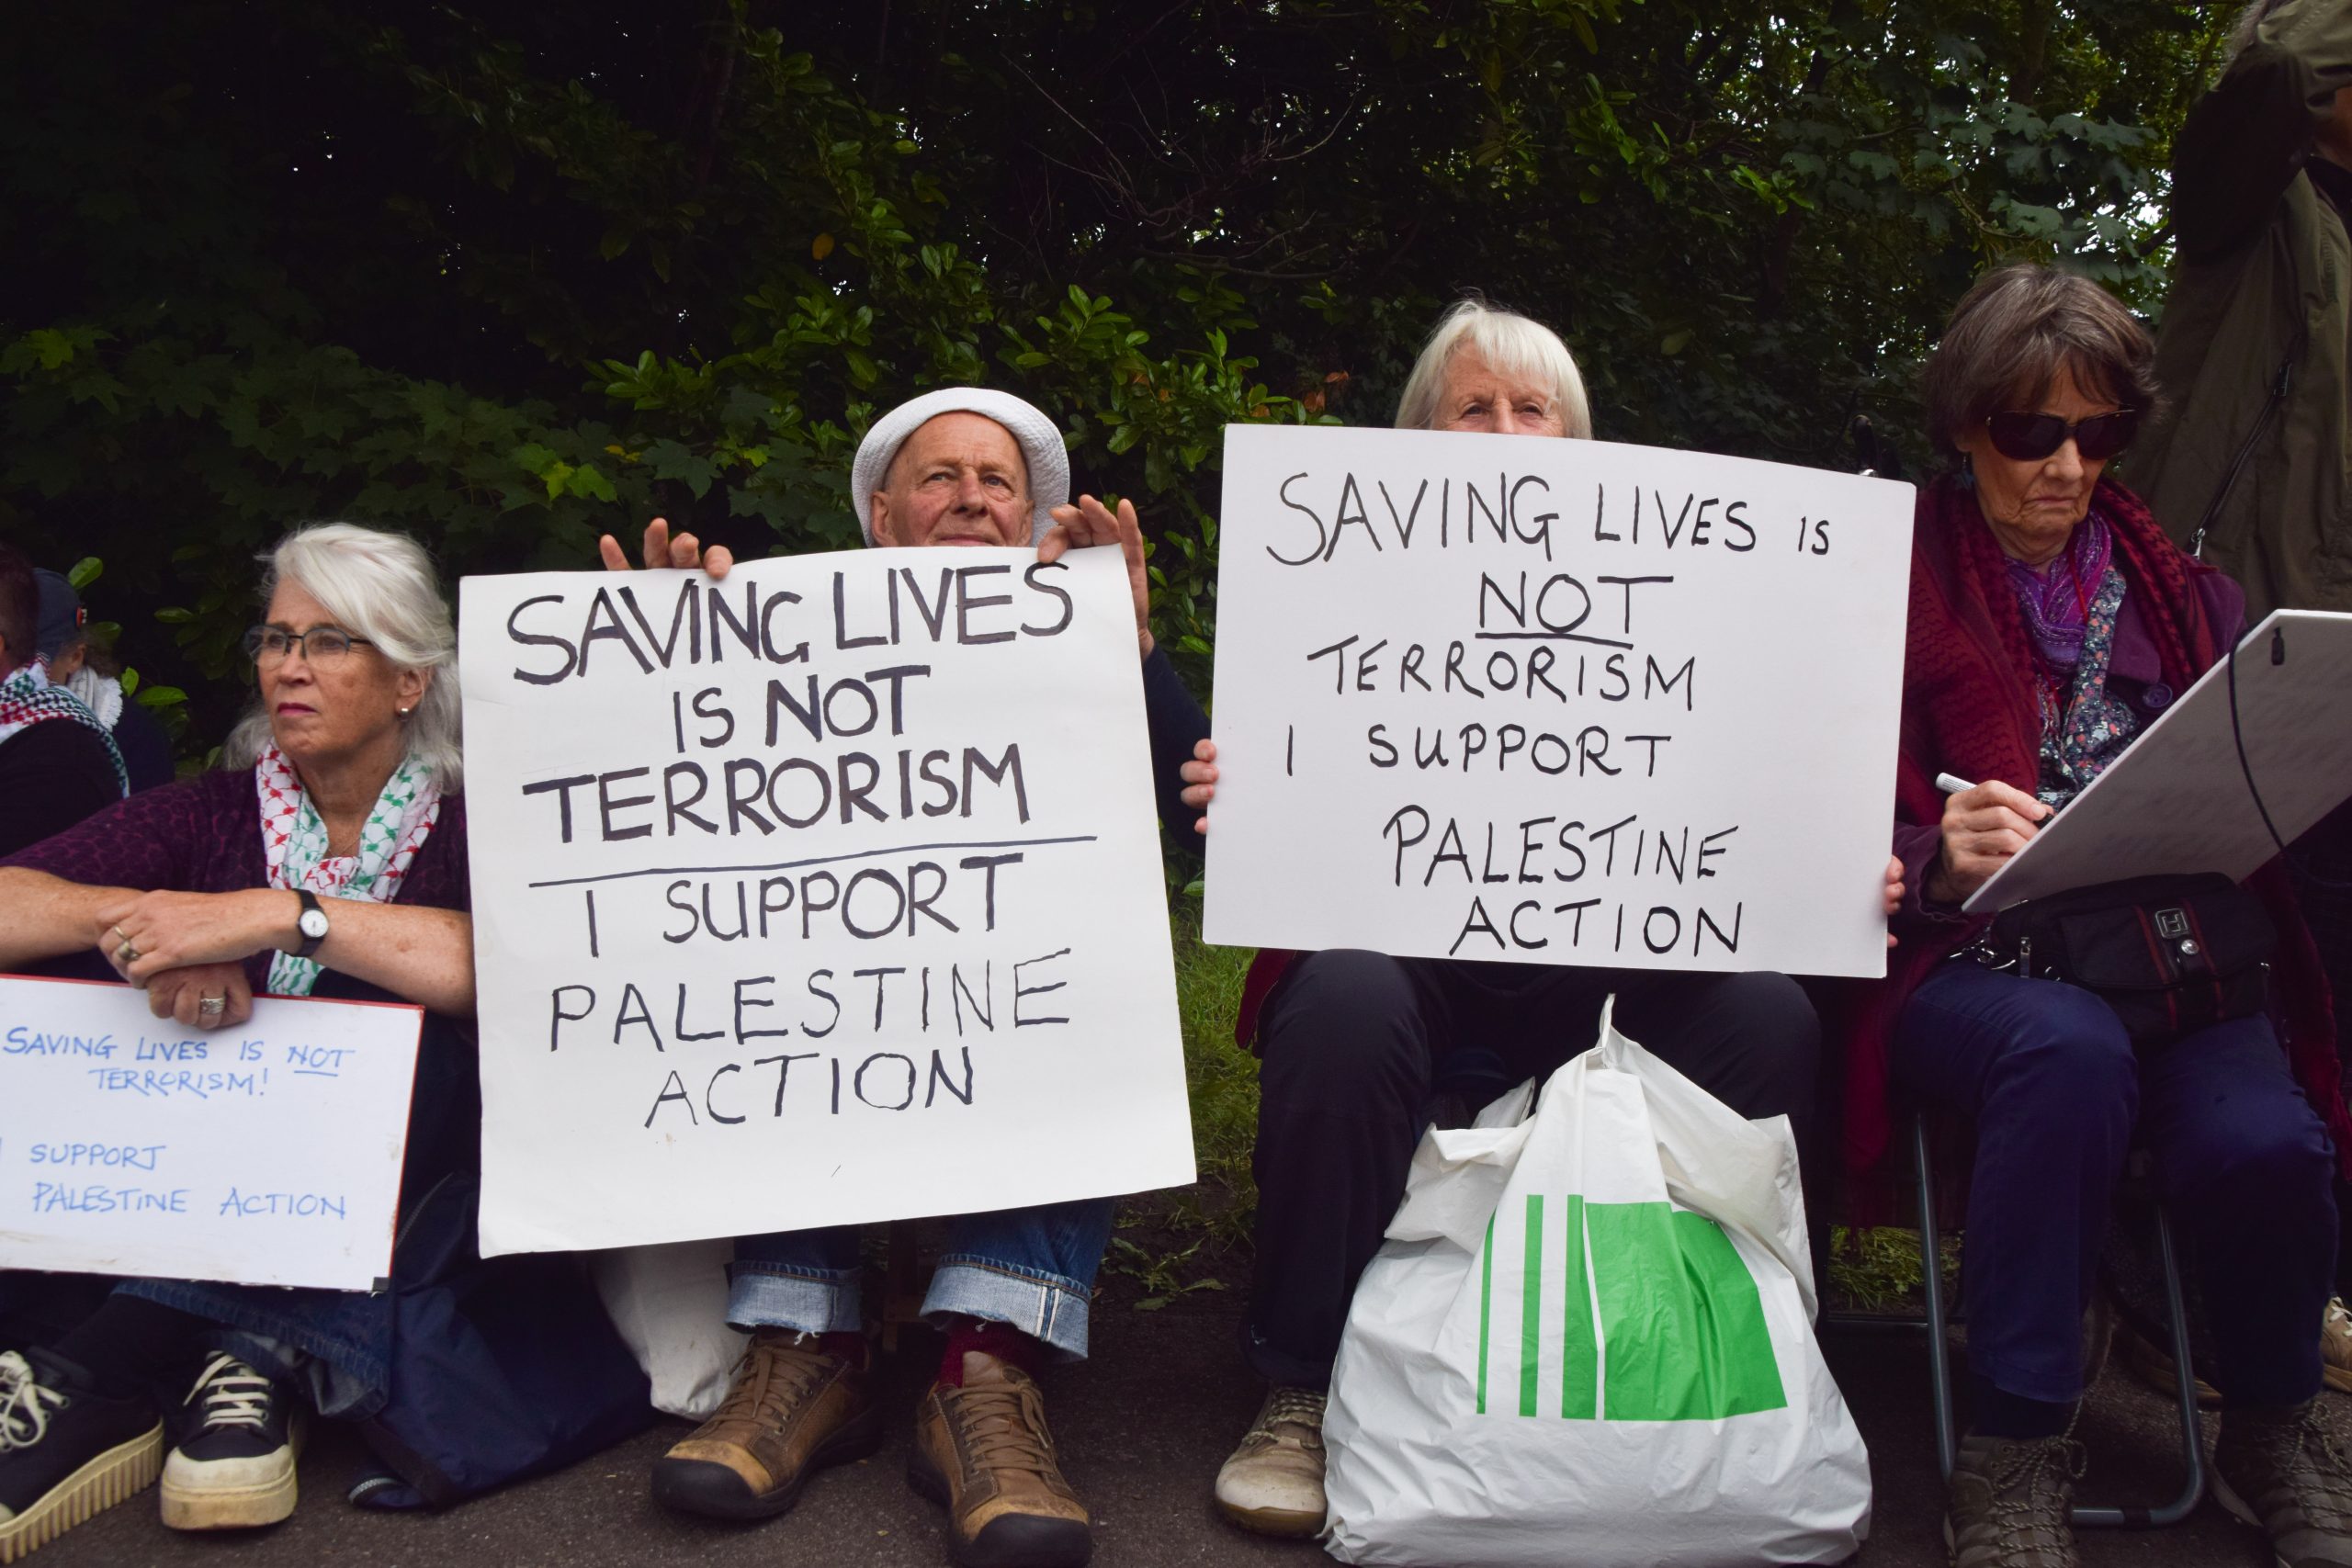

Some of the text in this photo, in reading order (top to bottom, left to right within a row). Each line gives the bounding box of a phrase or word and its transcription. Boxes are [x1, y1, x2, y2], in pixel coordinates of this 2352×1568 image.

[1266, 472, 1830, 566] SAVING LIVES IS
[507, 560, 1073, 685] SAVING LIVES
[1479, 570, 1674, 634] NOT
[673, 664, 931, 753] IS NOT
[1307, 634, 1695, 711] TERRORISM
[1286, 723, 1671, 777] I SUPPORT
[522, 742, 1031, 843] TERRORISM
[1383, 805, 1739, 887] PALESTINE
[585, 852, 1023, 958] I SUPPORT
[1449, 896, 1743, 957] ACTION
[550, 947, 1071, 1053] PALESTINE
[2, 1026, 356, 1069] SAVING LIVES IS NOT
[88, 1067, 268, 1099] TERRORISM!
[644, 1045, 974, 1129] ACTION
[29, 1144, 167, 1171] SUPPORT
[32, 1181, 346, 1221] PALESTINE ACTION
